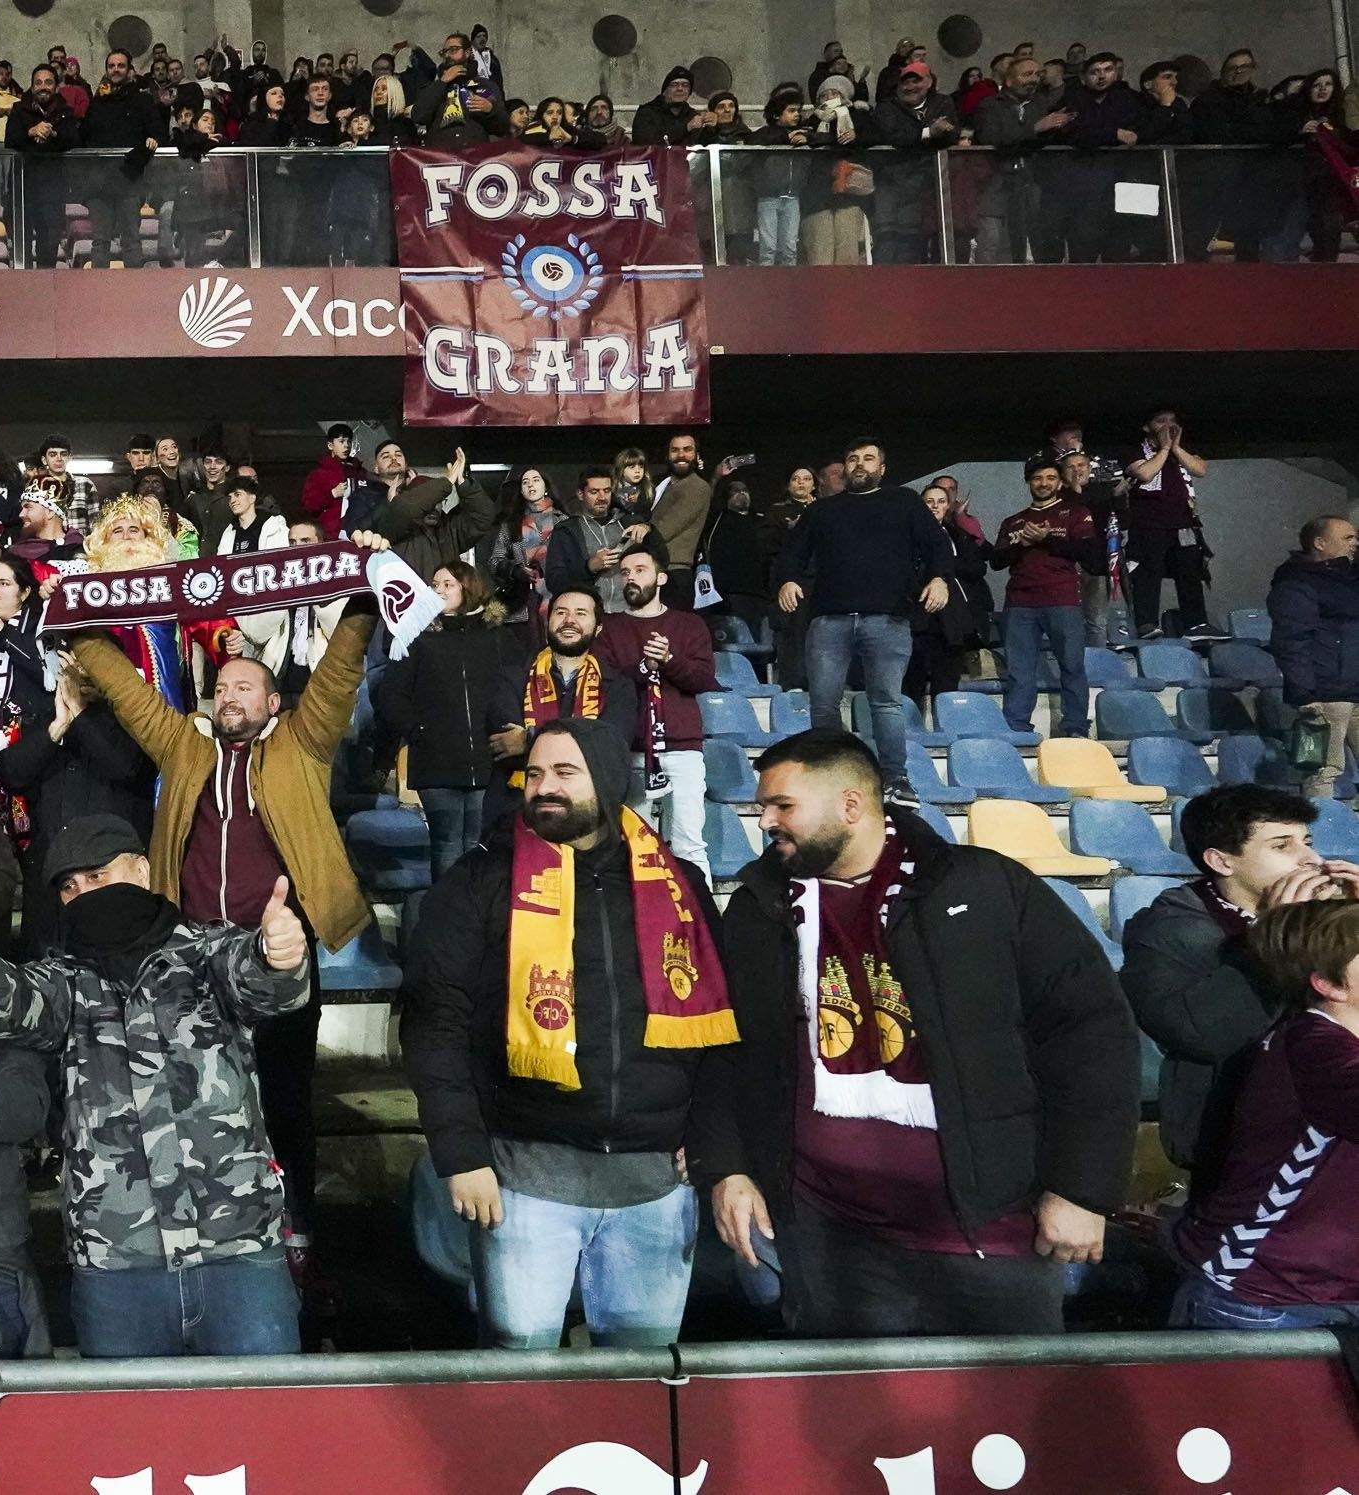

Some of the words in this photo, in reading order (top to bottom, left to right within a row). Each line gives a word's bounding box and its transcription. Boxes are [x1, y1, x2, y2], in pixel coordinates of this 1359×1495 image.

[420, 160, 666, 228] FOSSA
[423, 318, 696, 398] GRANA
[61, 575, 173, 610] FOSSA
[230, 551, 361, 595] GRANA
[821, 996, 854, 1010] EDRA
